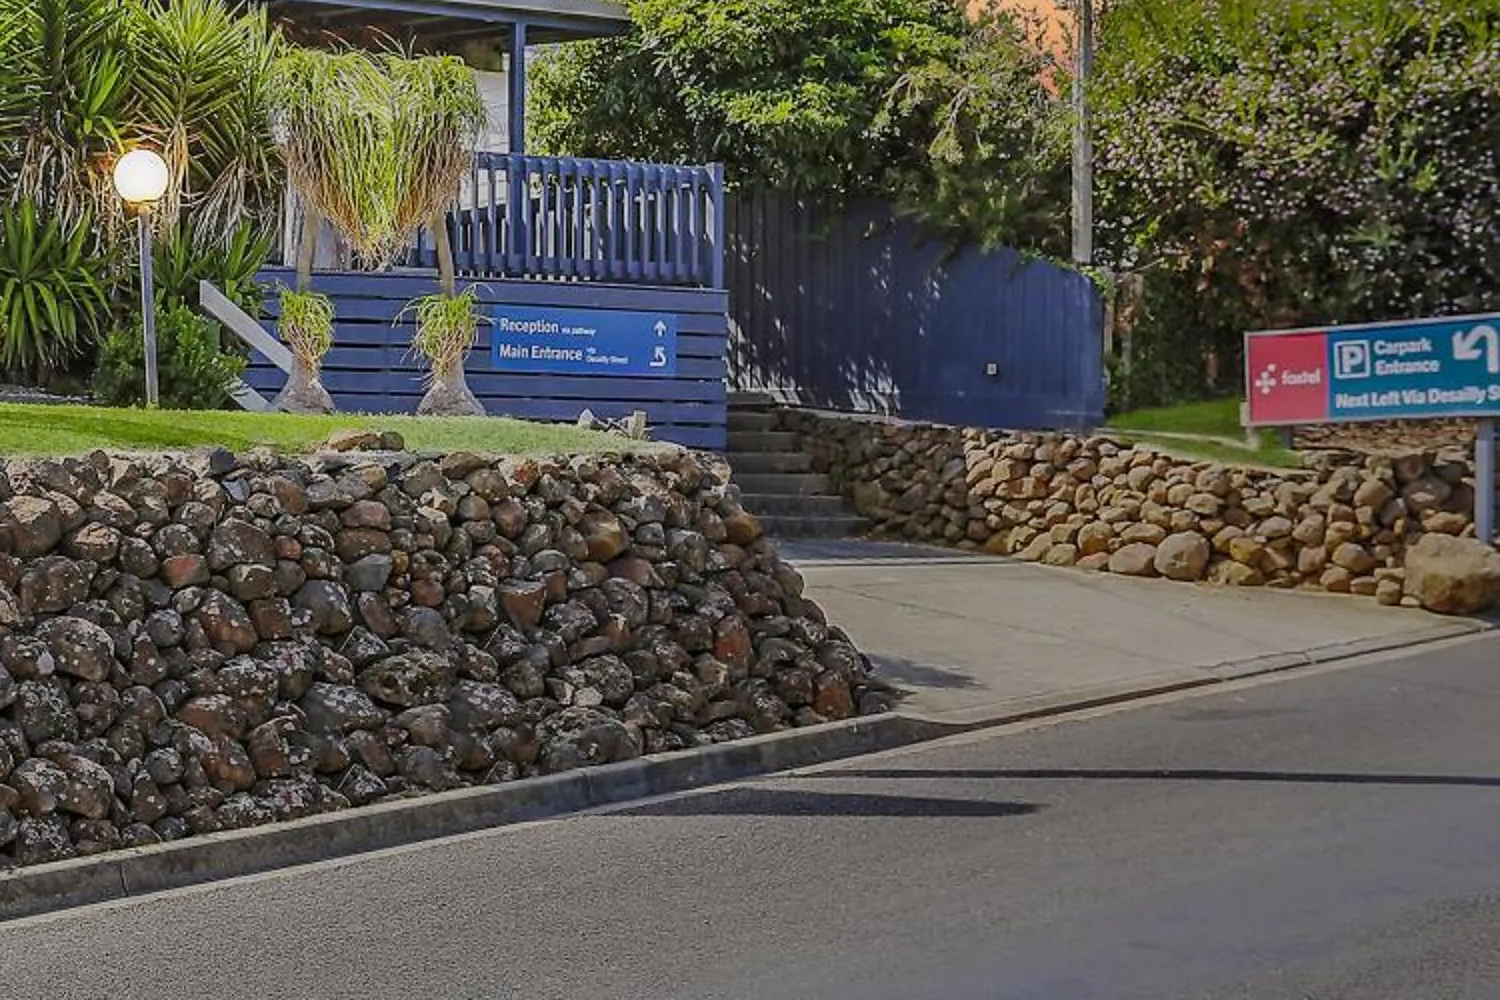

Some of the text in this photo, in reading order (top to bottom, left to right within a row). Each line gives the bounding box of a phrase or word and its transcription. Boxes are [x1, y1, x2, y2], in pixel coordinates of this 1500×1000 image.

[500, 317, 559, 334] Reception
[500, 343, 529, 359] Main
[531, 345, 583, 361] Entrance
[1374, 337, 1432, 356] Carpark
[1341, 344, 1363, 374] P
[1375, 359, 1441, 376] Entrance
[1281, 367, 1321, 385] foxtel
[1335, 391, 1369, 409] Next
[1371, 390, 1401, 407] Left
[1401, 388, 1427, 405] Via
